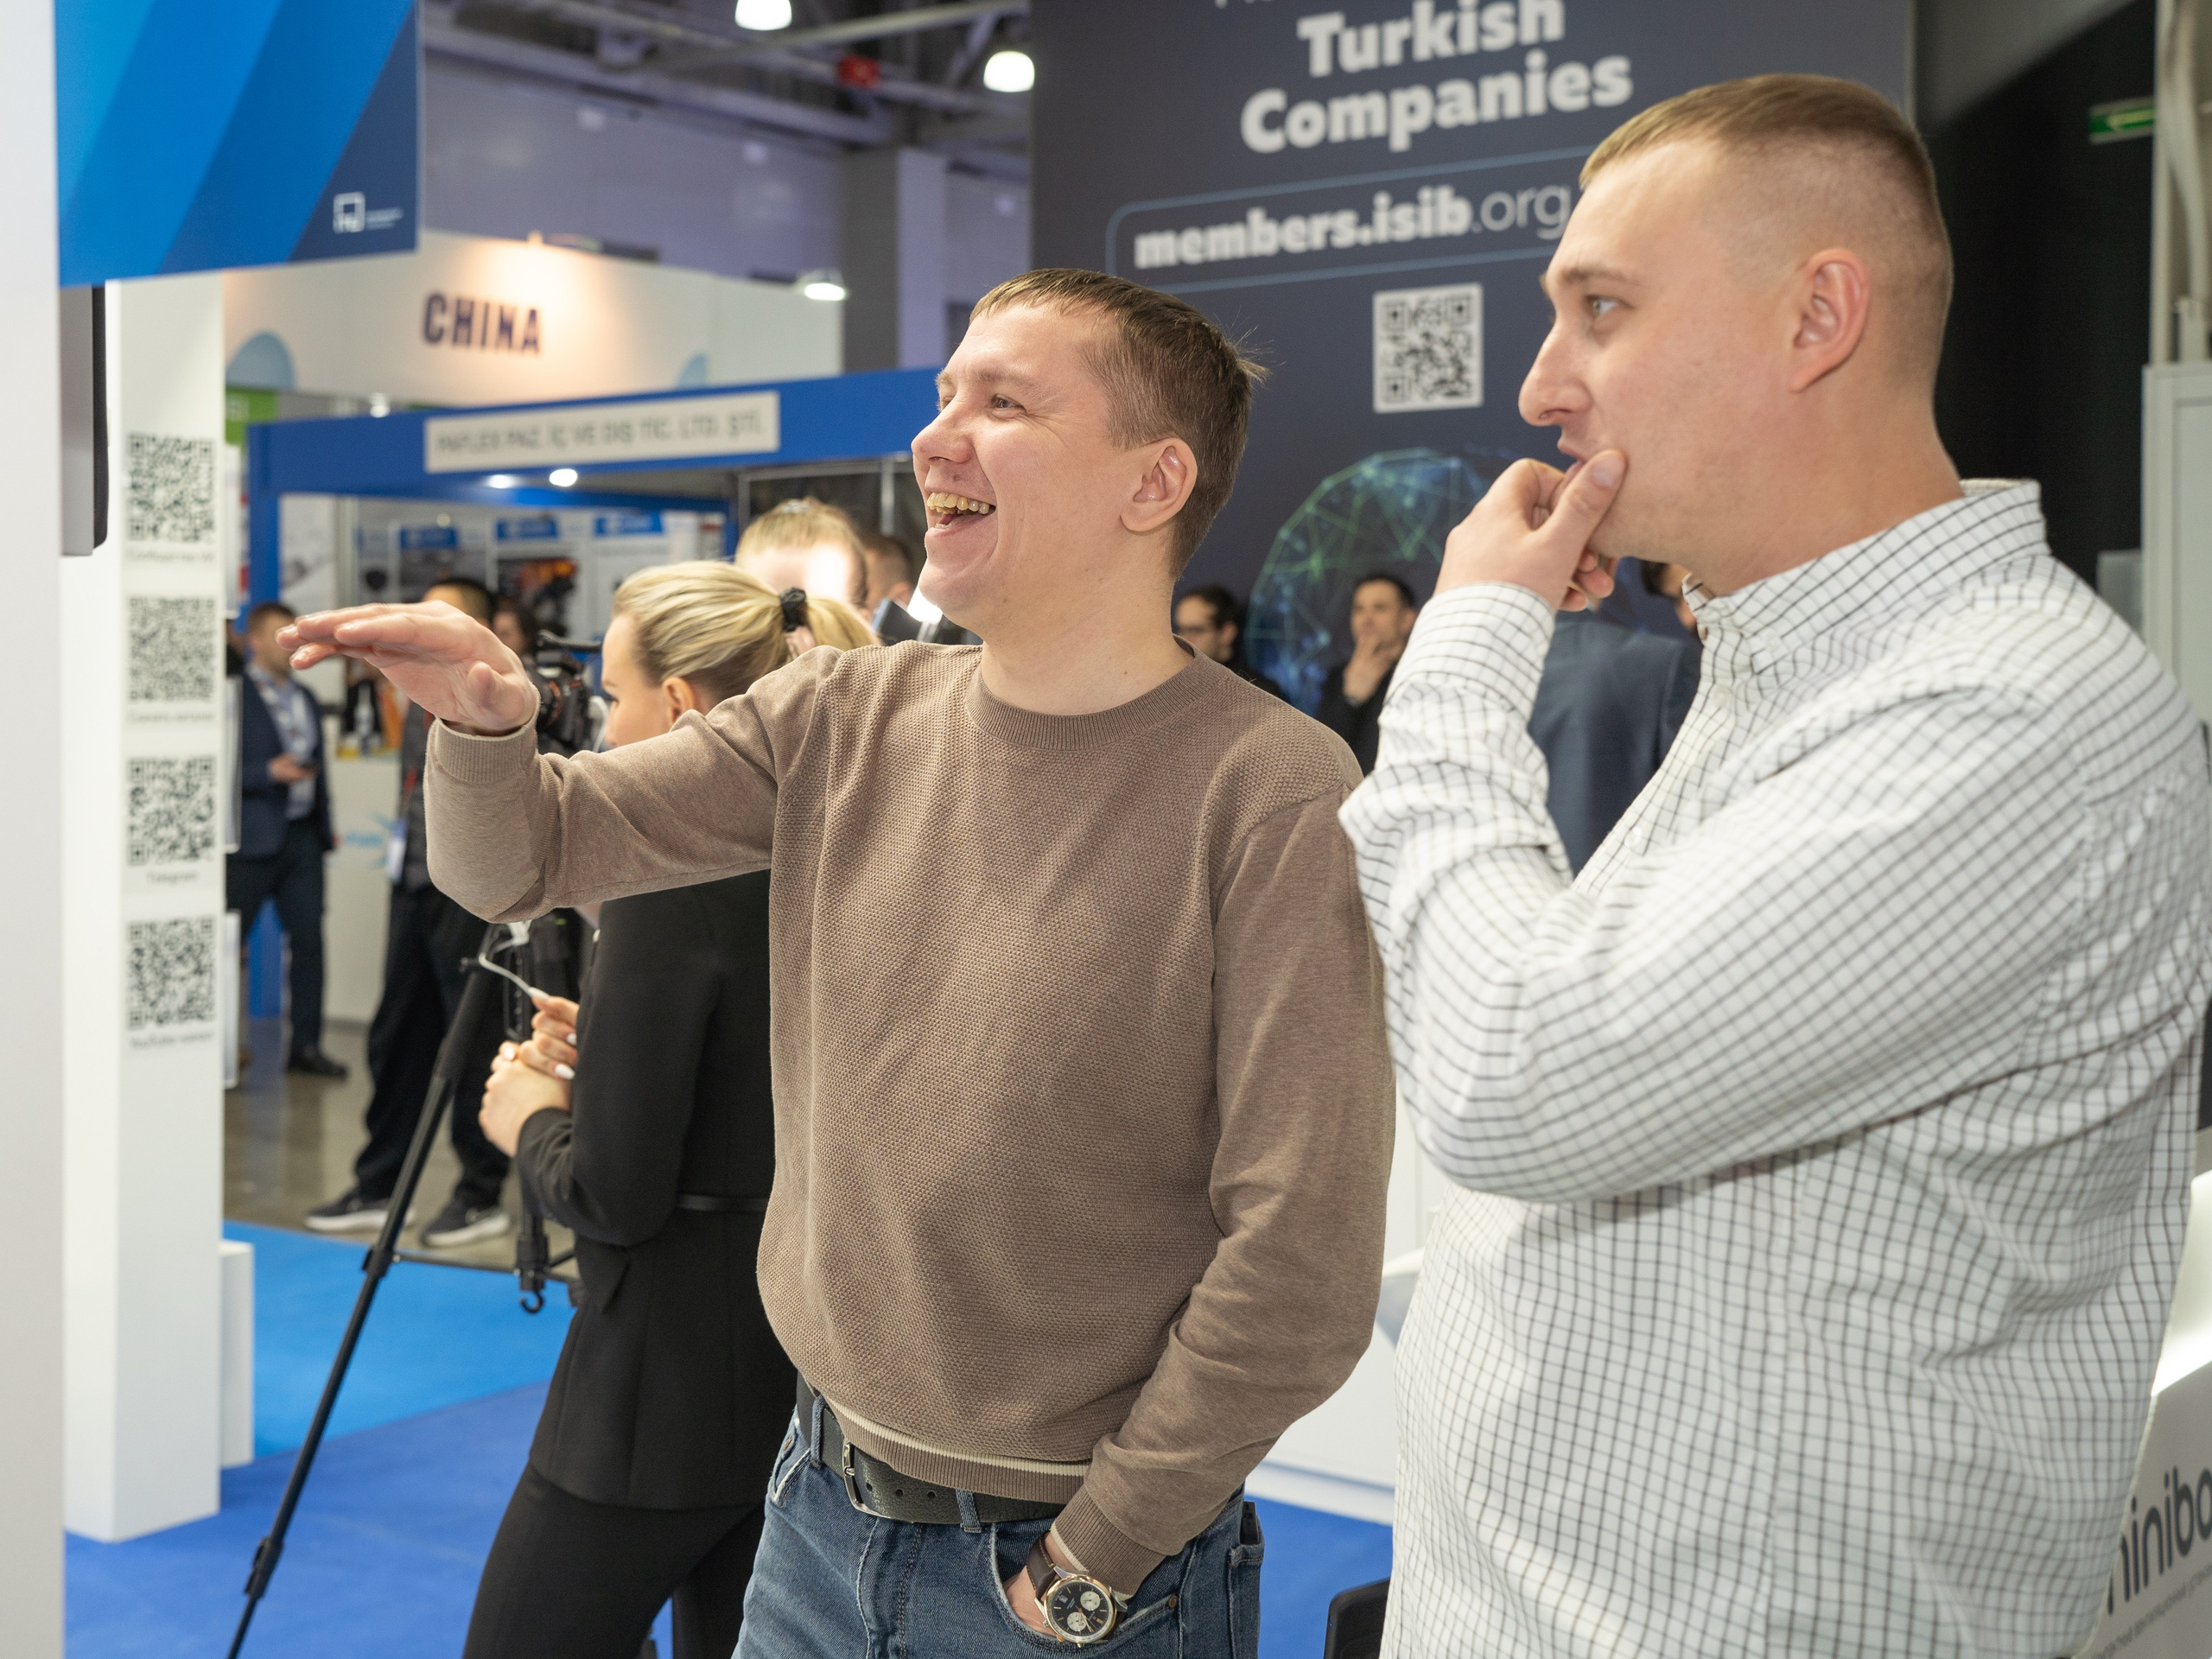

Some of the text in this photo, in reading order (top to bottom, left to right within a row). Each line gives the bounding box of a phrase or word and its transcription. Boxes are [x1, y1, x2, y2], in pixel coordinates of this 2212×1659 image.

[1297, 0, 1565, 77] Turkish
[1241, 49, 1634, 153] Companies
[421, 293, 542, 355] CHINA
[2107, 1465, 2212, 1616] inibo
